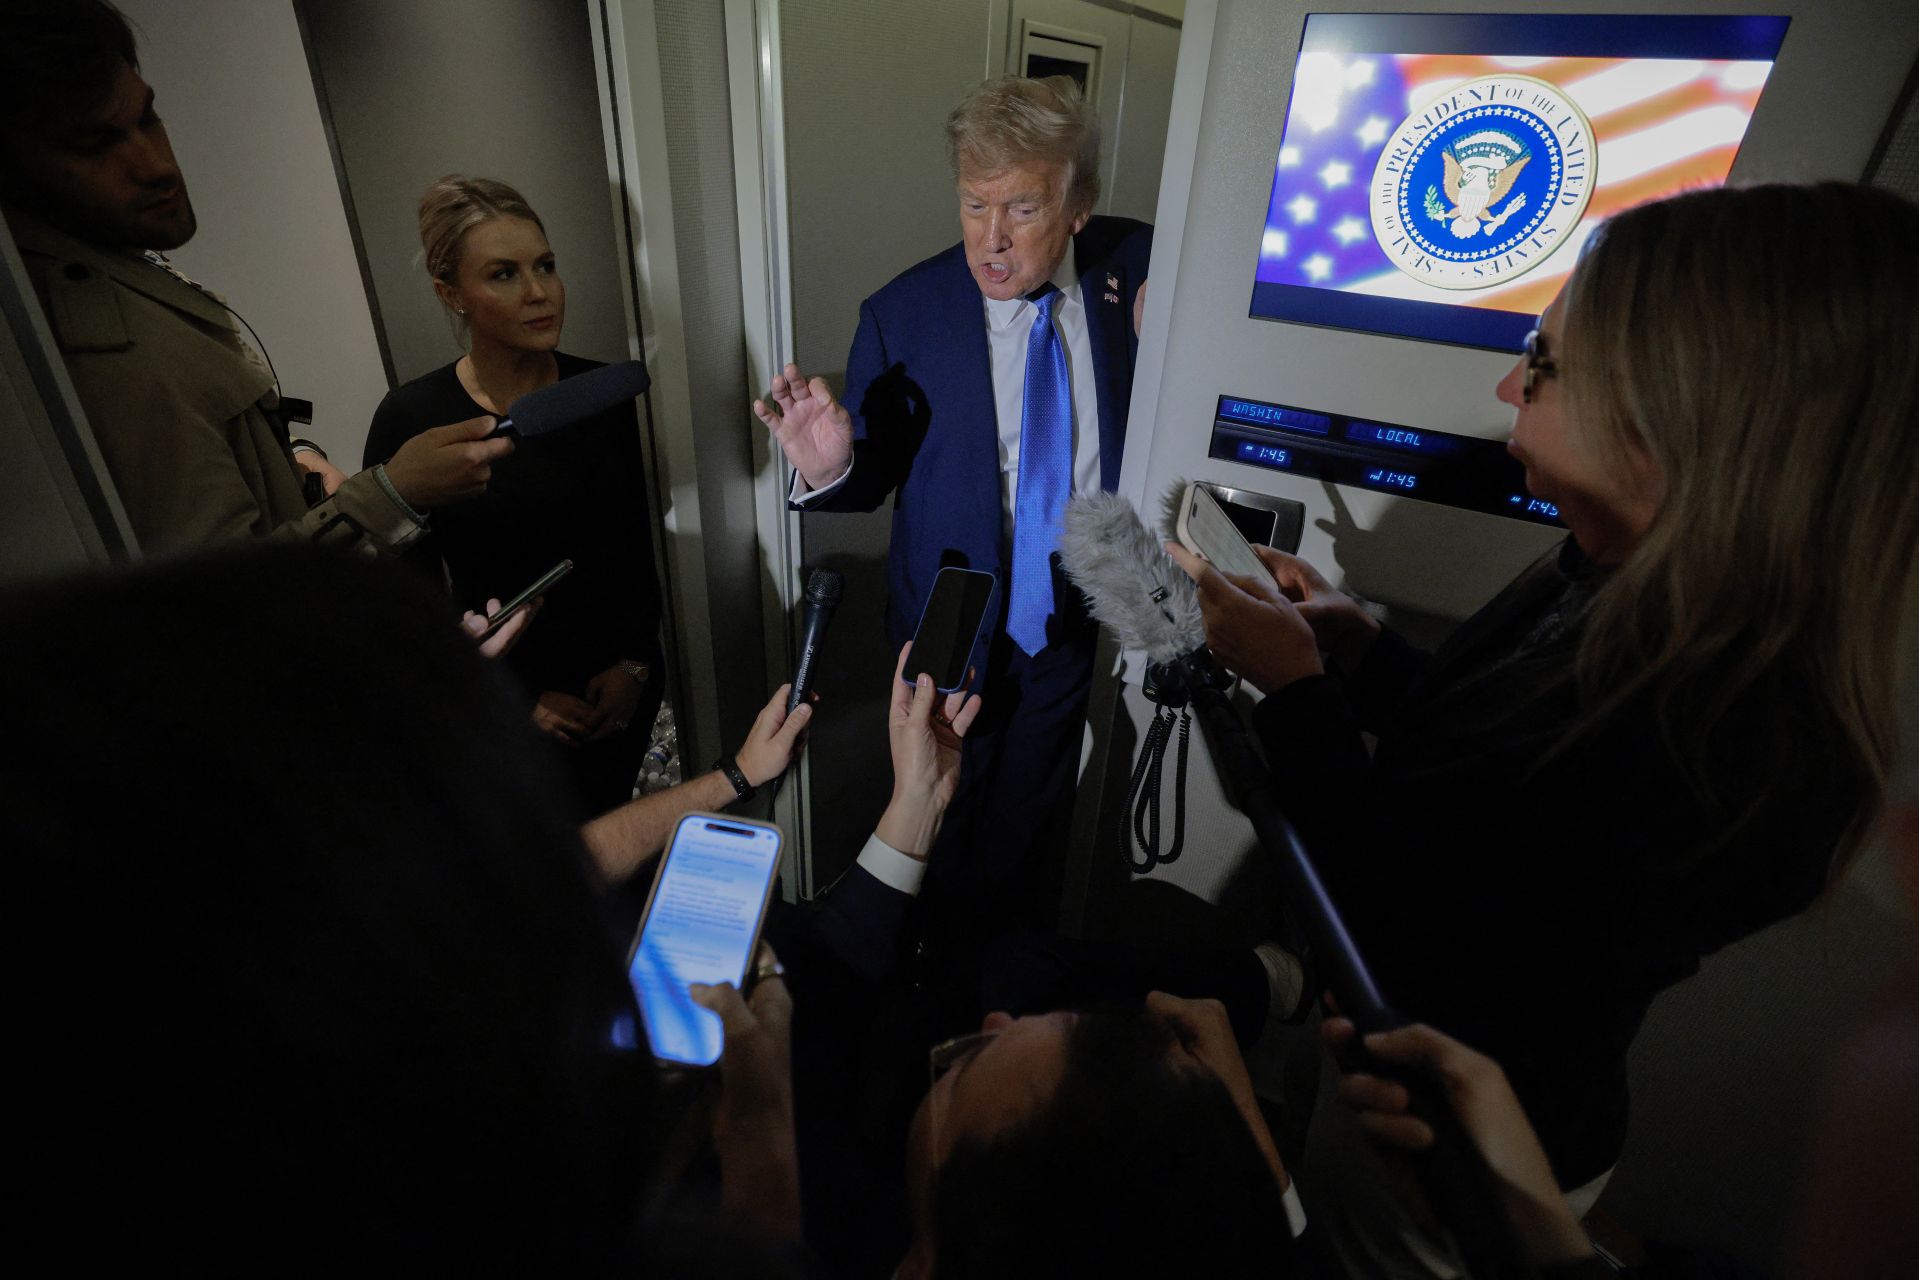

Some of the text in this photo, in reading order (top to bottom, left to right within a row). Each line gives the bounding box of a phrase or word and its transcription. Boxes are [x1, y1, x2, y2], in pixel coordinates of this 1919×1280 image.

[1505, 88, 1525, 100] OF
[1531, 94, 1559, 114] THE
[1386, 85, 1501, 173] PRESIDENT
[1556, 115, 1585, 207] UNITED
[1392, 232, 1437, 273] SEAL
[1473, 225, 1557, 277] STATES
[1376, 428, 1421, 446] LOCAL
[1259, 448, 1286, 462] 1:45
[1527, 499, 1559, 516] 1:45
